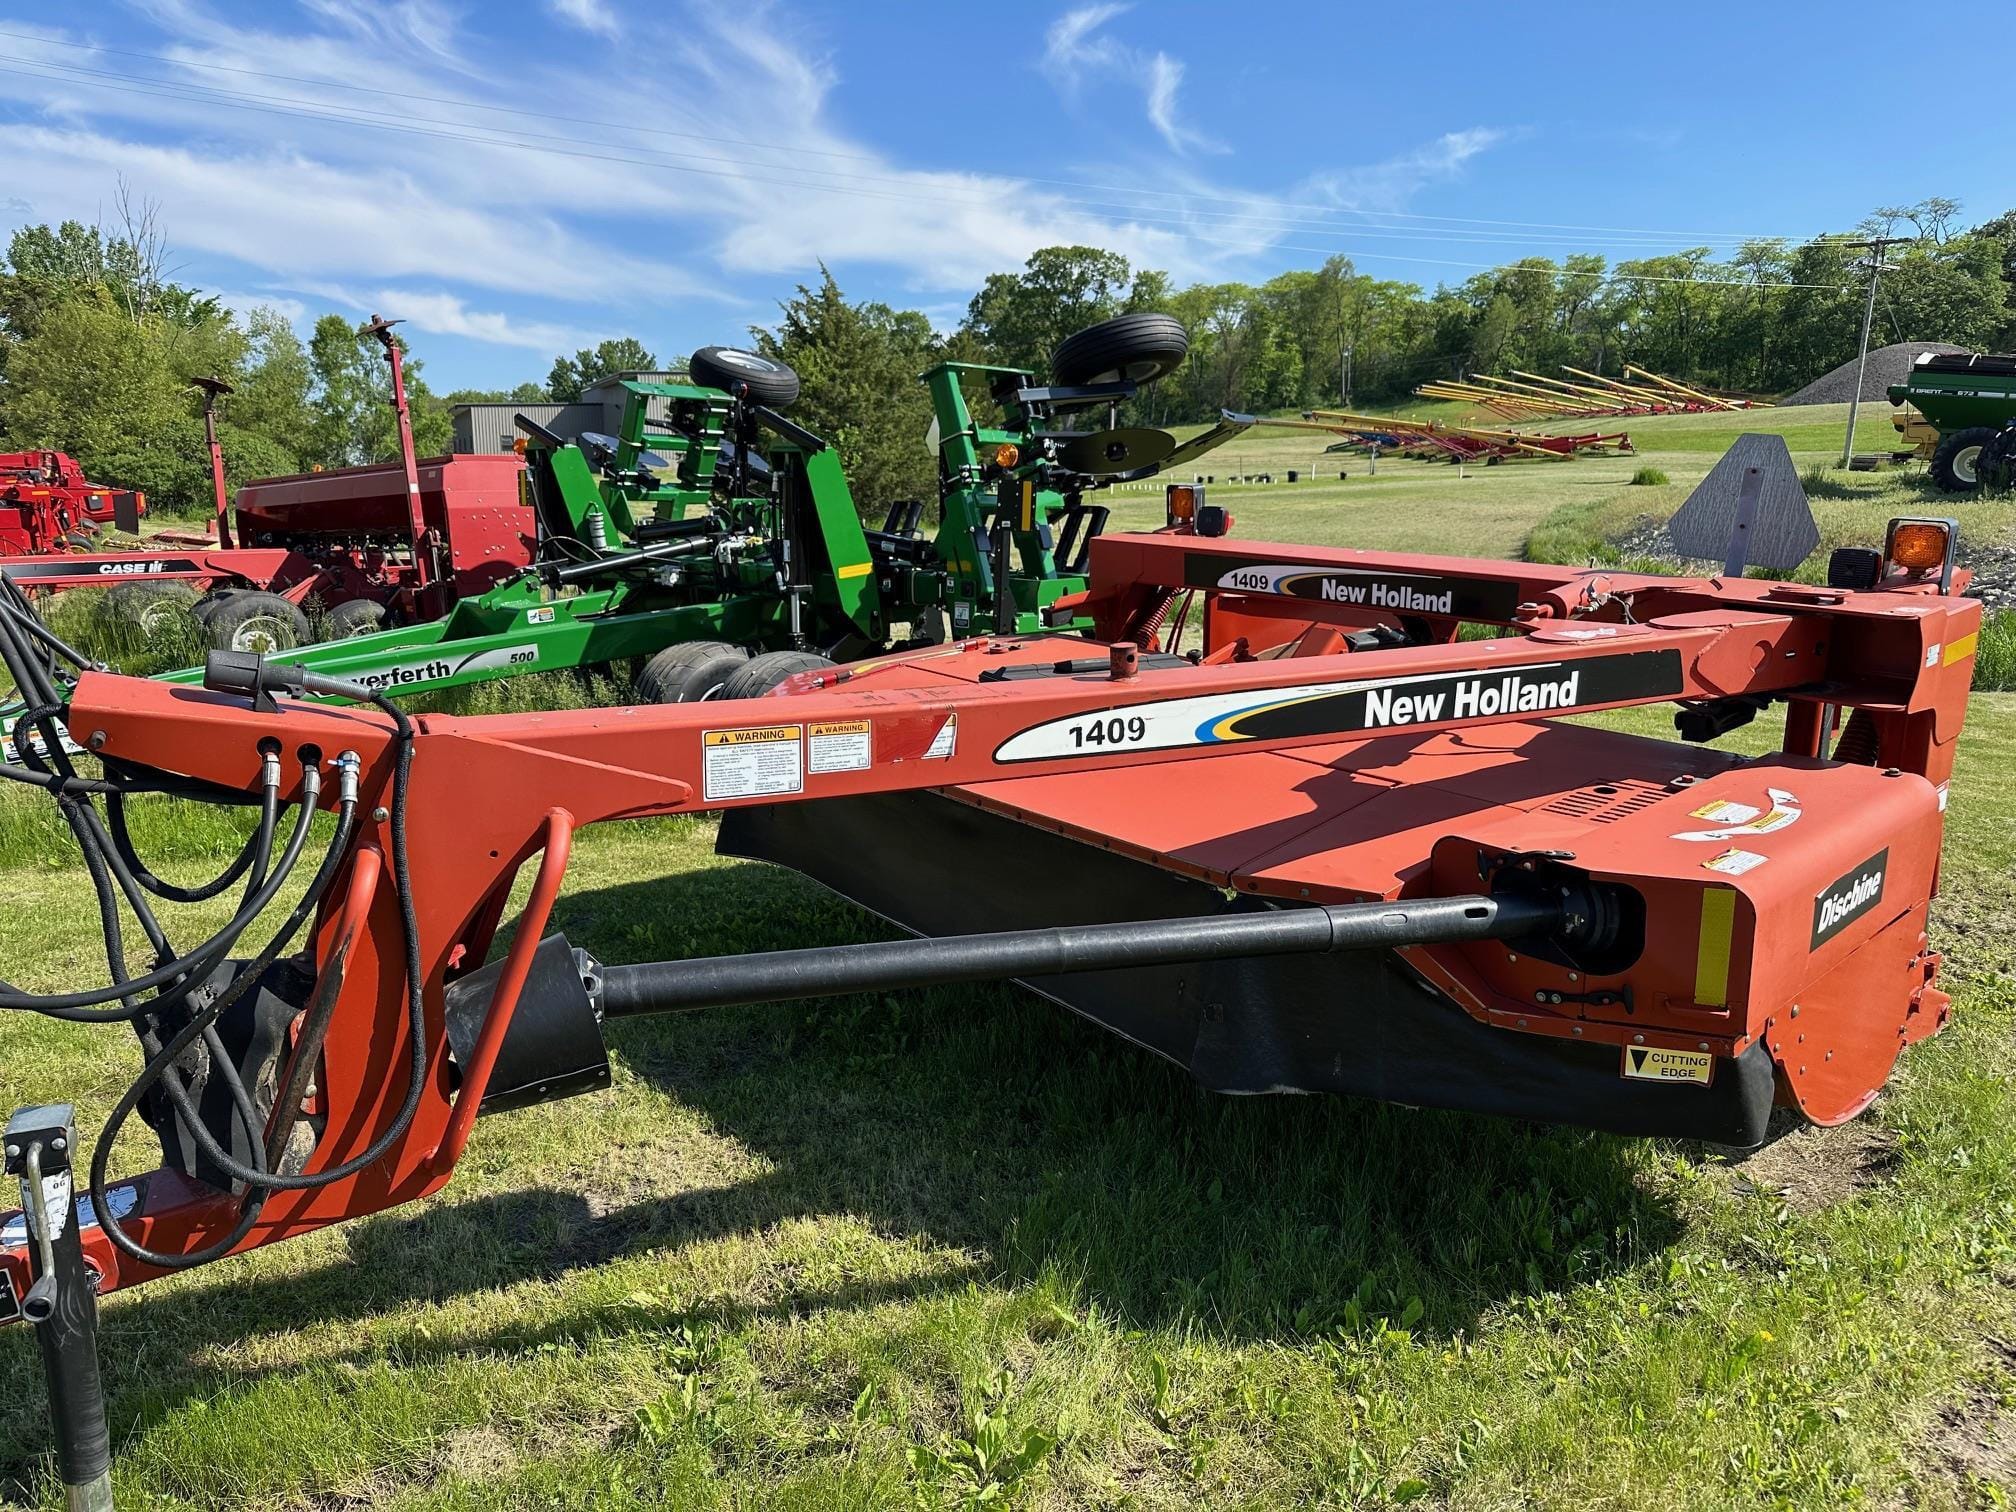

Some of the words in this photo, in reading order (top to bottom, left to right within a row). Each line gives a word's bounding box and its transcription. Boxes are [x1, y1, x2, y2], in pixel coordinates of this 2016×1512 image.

[99, 563, 146, 574] CASE
[1230, 572, 1269, 590] 1409
[1321, 578, 1367, 603] New
[1371, 583, 1452, 613] Holland
[509, 650, 535, 664] 500
[1069, 715, 1146, 748] 1409
[1364, 688, 1446, 728] New
[1454, 670, 1579, 719] Holland
[734, 730, 785, 741] WARNING
[825, 724, 864, 733] WARNING
[1817, 871, 1882, 934] Discbine
[1651, 1053, 1708, 1067] CUTTING
[1661, 1067, 1697, 1078] EDGE
